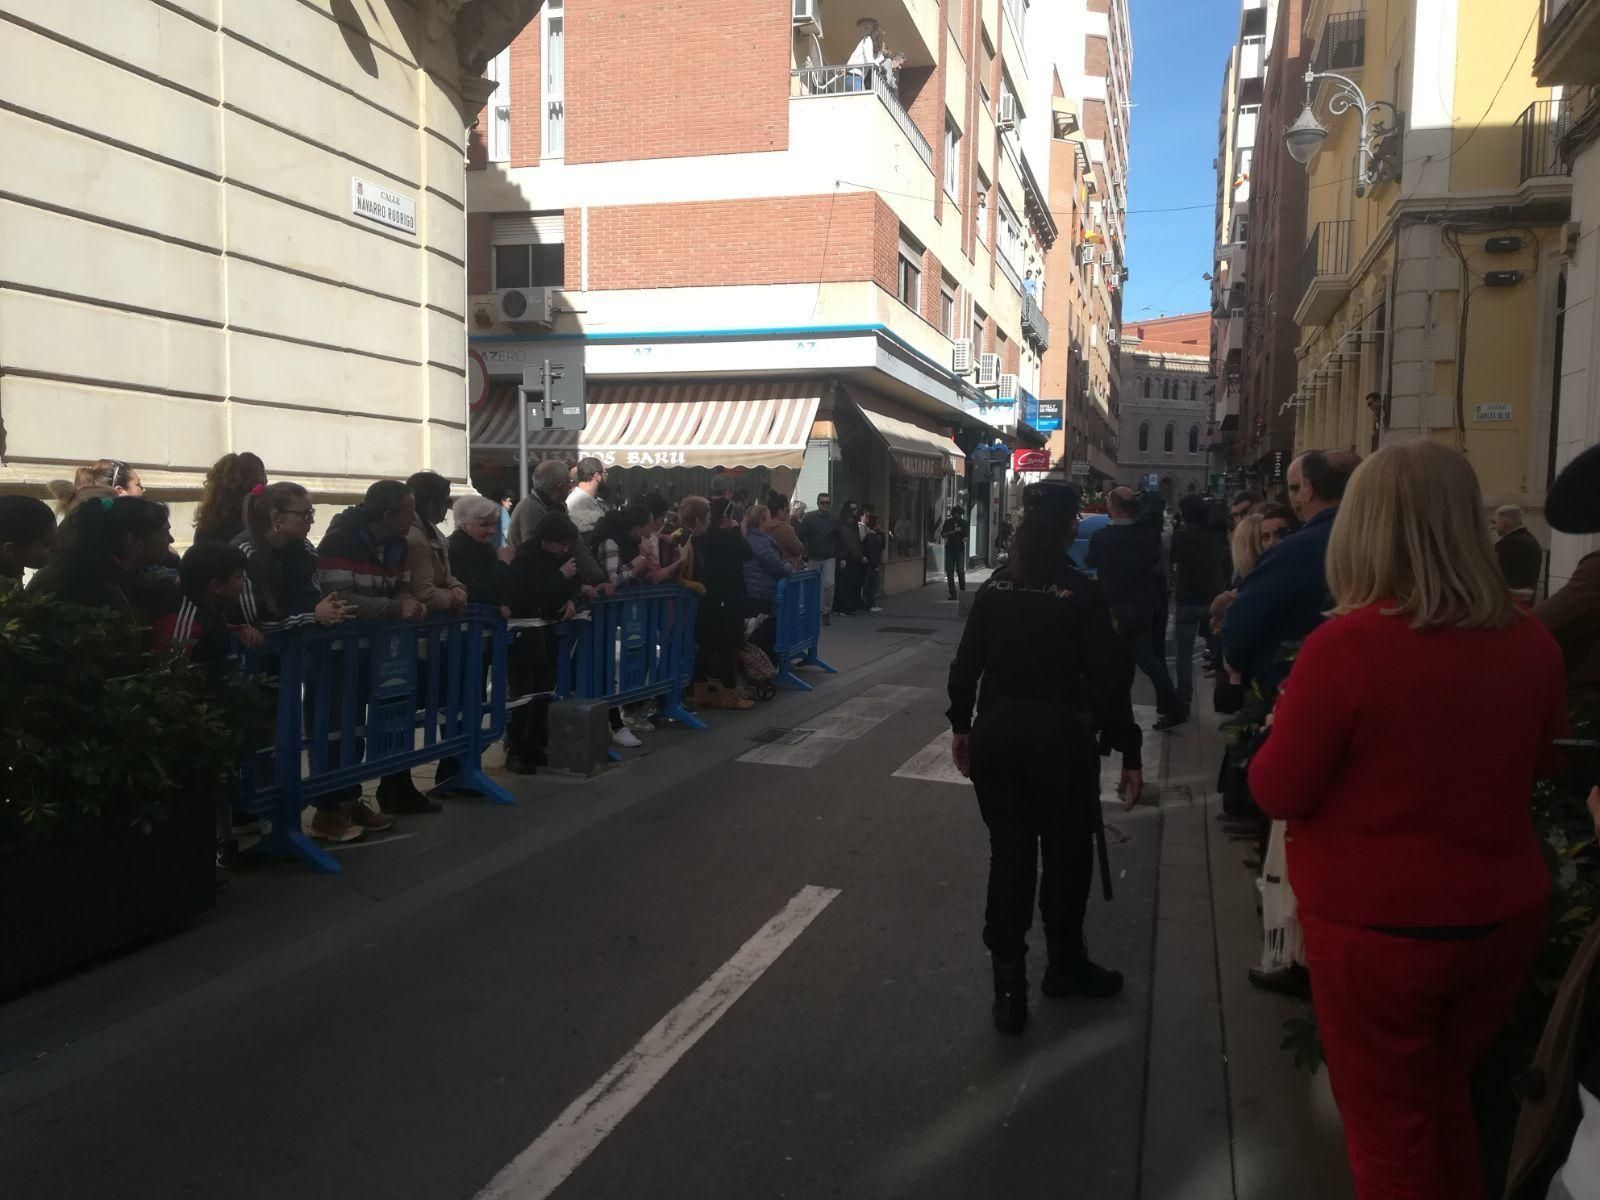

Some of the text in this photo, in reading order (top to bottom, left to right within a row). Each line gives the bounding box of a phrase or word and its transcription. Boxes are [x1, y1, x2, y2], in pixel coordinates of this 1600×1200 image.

[380, 191, 401, 205] CALLE
[357, 196, 414, 229] NAVARRO RODRIGO
